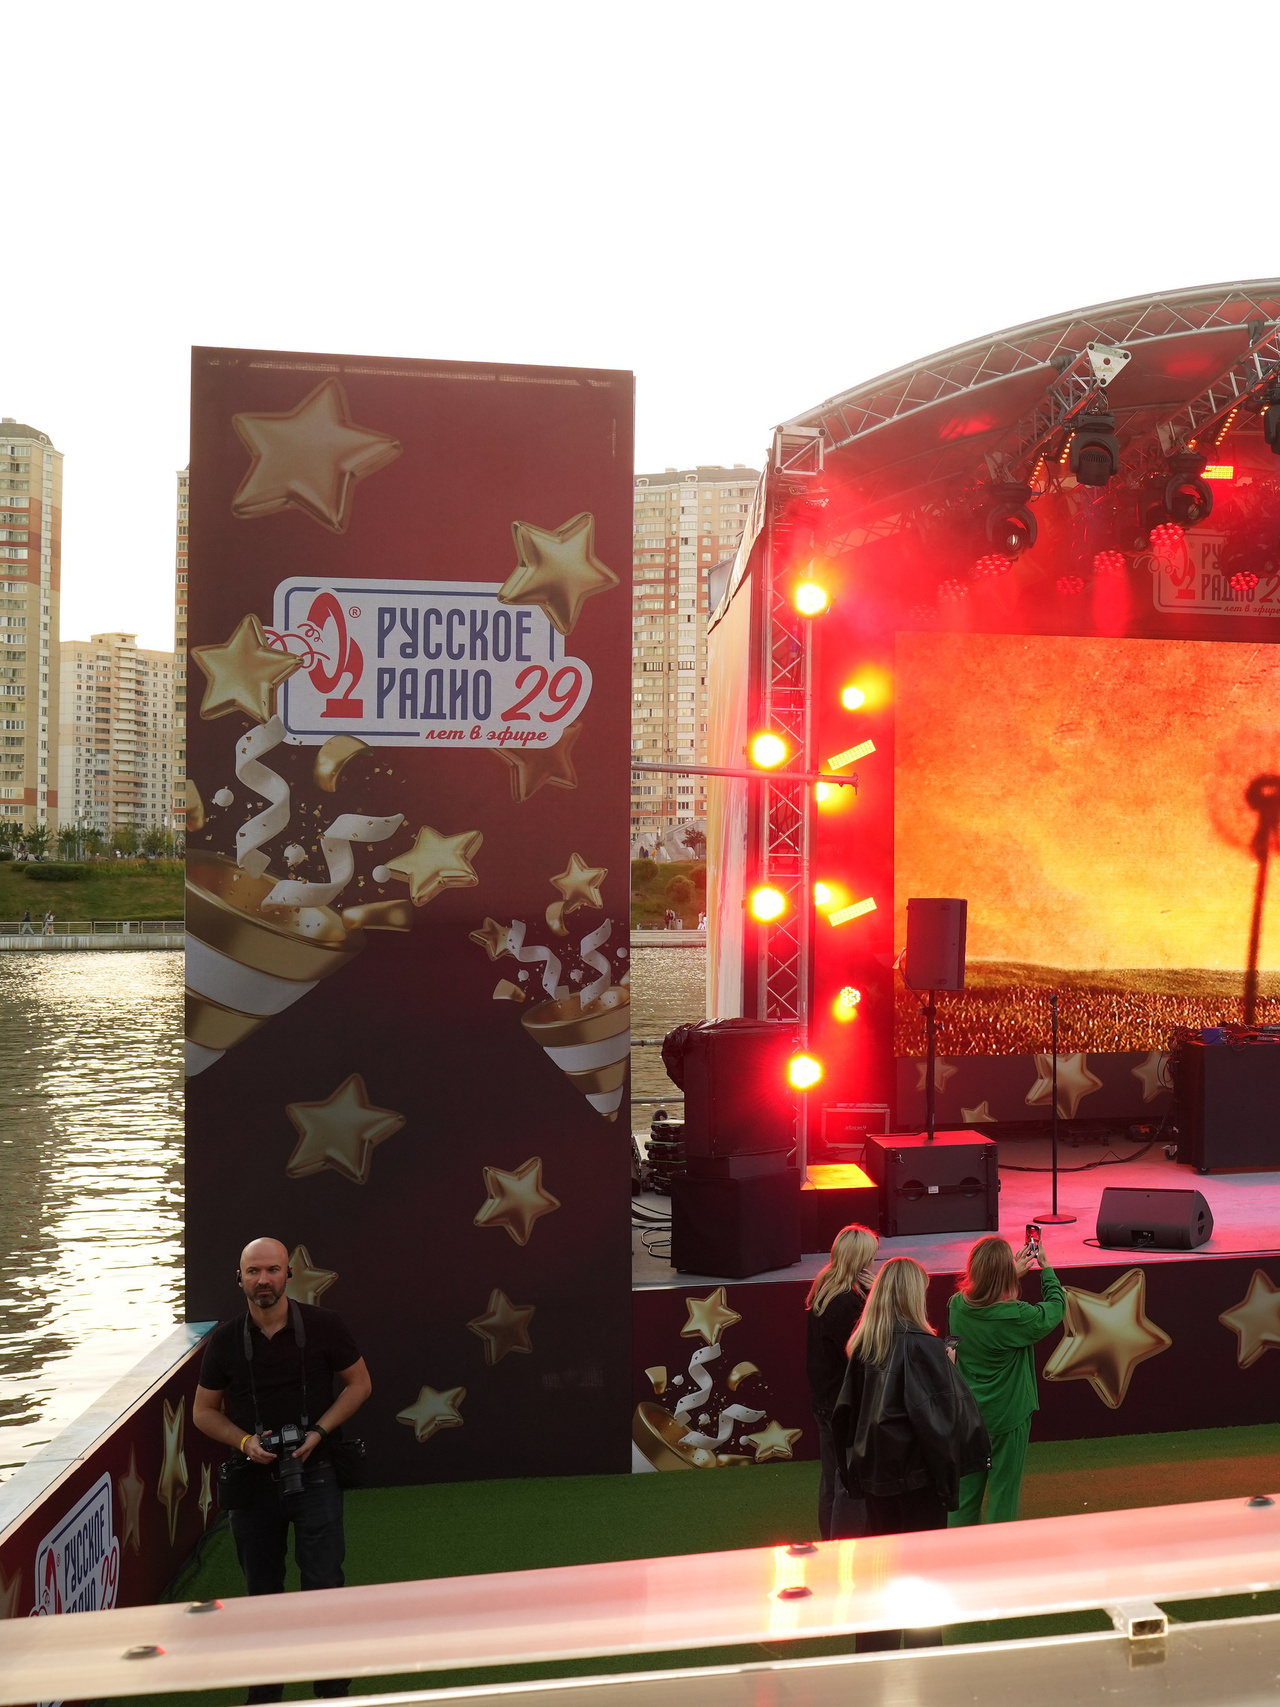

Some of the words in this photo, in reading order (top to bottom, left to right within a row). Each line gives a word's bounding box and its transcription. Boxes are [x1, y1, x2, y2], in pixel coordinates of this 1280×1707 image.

[377, 606, 532, 662] РУССКОЕ
[1244, 604, 1251, 613] в
[1252, 605, 1280, 616] эфире
[376, 667, 492, 721] РАДИО
[500, 664, 583, 723] 29
[425, 729, 466, 741] лет
[469, 725, 483, 741] в
[486, 726, 549, 747] эфире
[65, 1504, 105, 1601] РУССКОЕ
